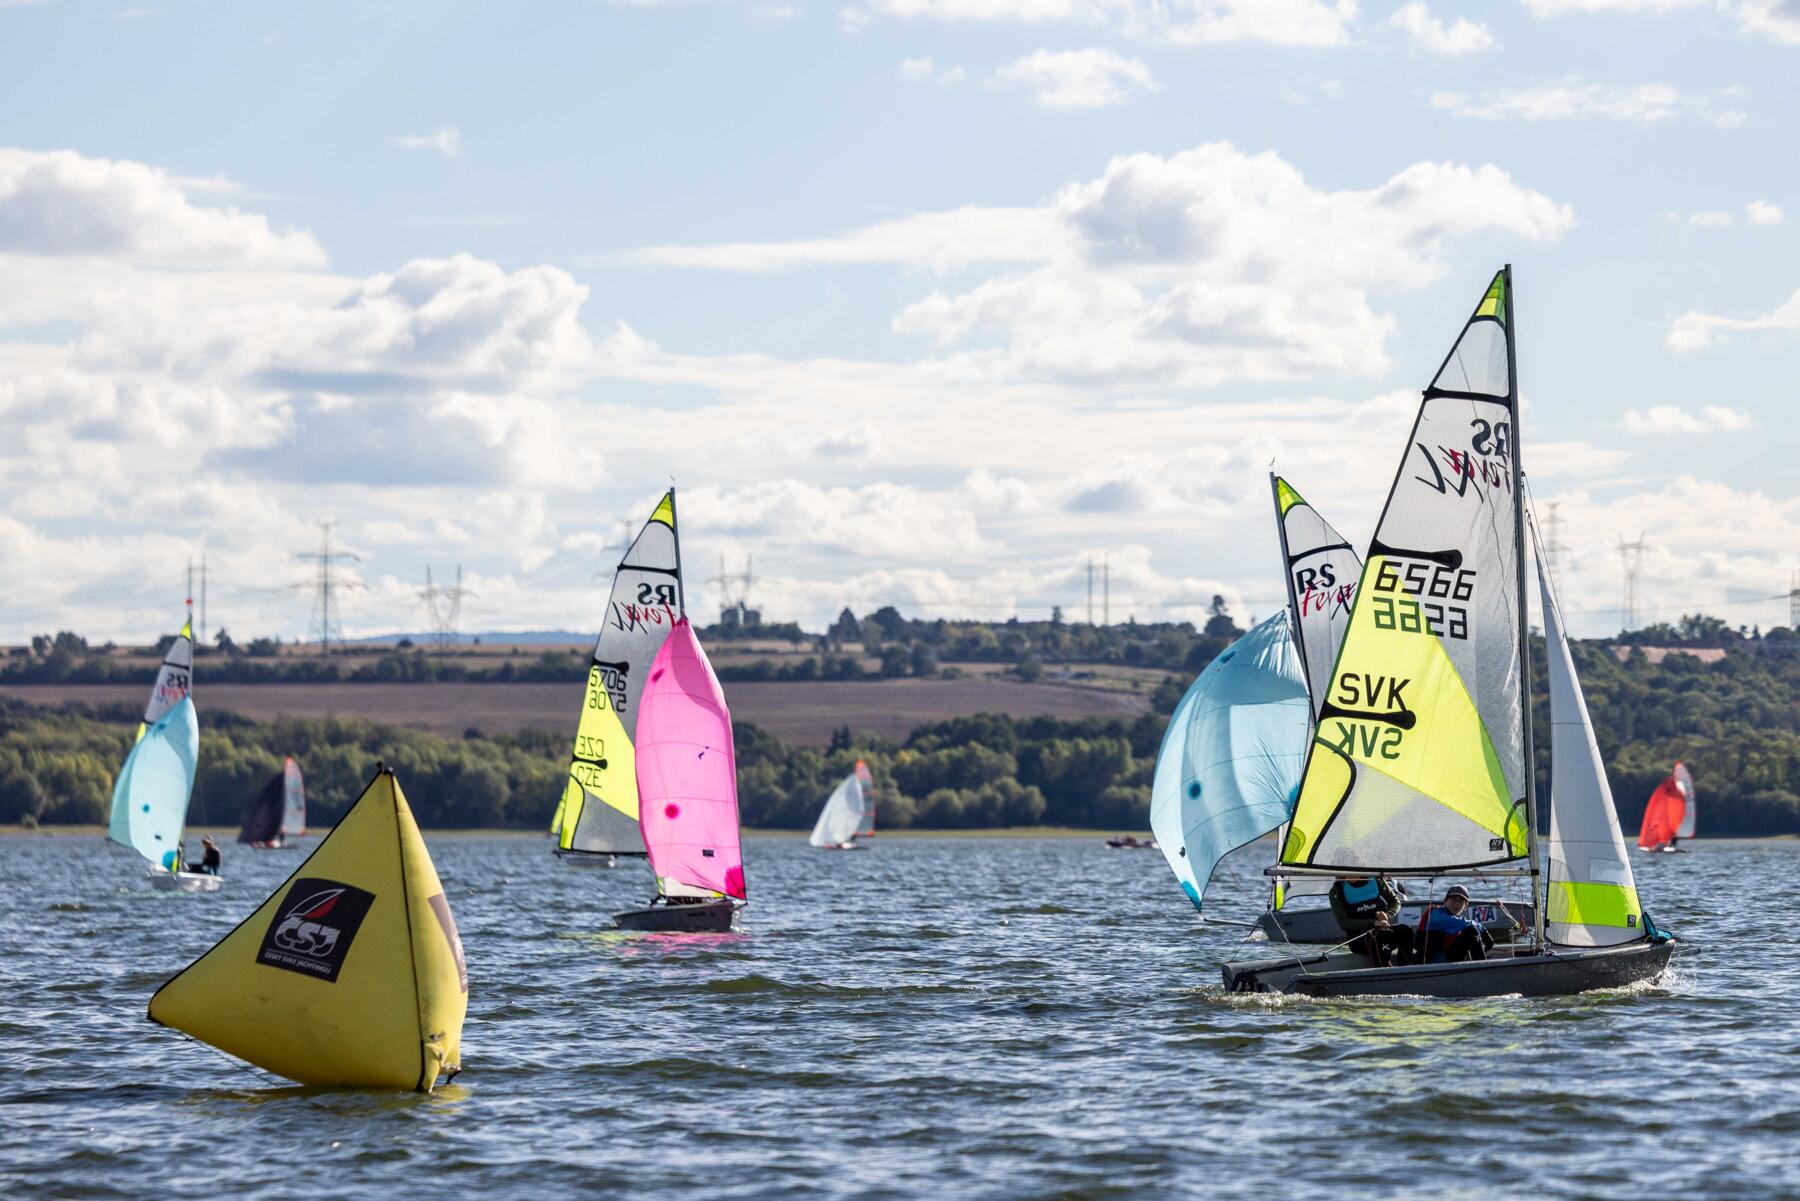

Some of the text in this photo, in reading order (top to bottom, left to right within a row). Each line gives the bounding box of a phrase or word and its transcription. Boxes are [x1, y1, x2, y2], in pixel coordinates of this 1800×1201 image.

[1296, 563, 1336, 595] RS
[1373, 560, 1477, 601] 6566
[590, 667, 628, 692] 5706
[1337, 672, 1411, 711] SVK
